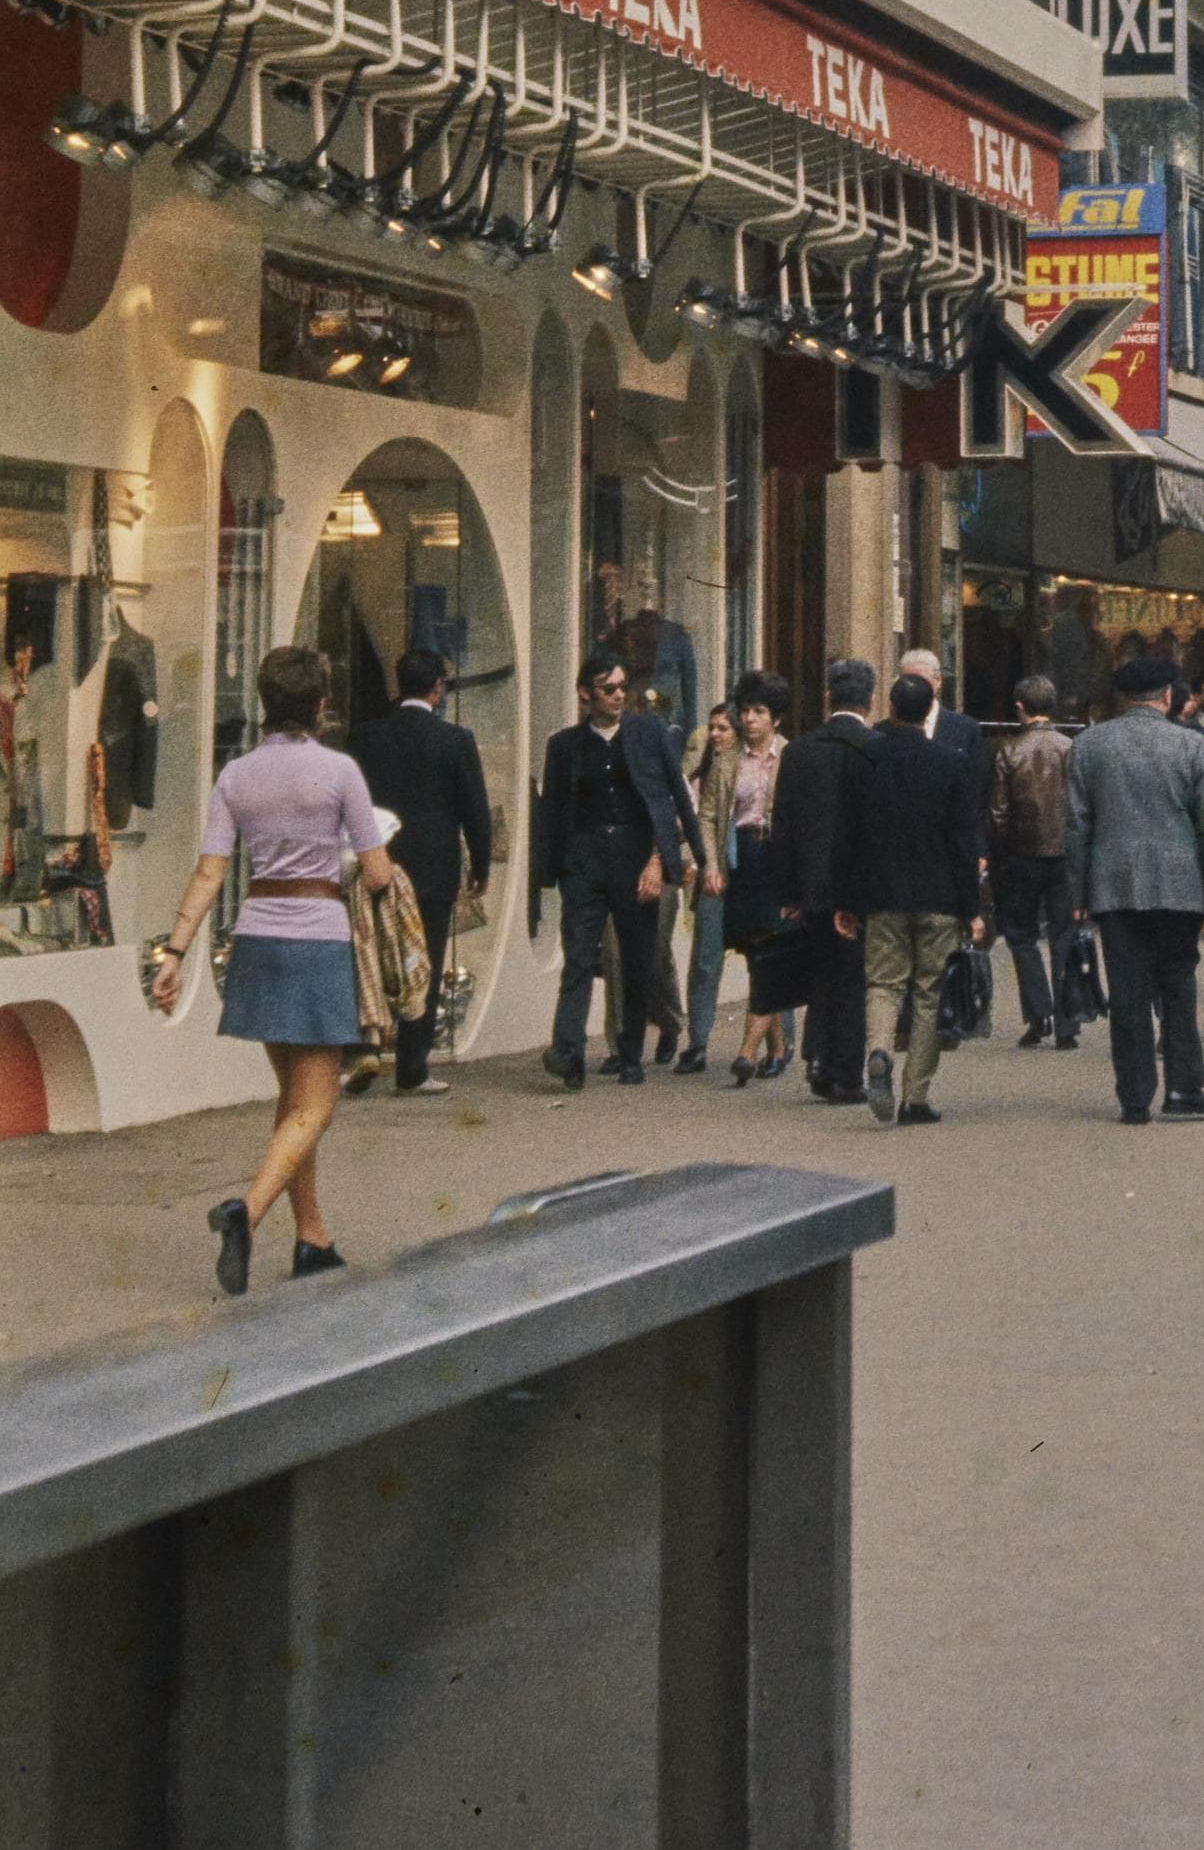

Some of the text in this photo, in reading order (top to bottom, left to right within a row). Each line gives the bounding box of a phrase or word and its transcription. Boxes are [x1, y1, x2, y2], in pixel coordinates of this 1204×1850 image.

[806, 33, 891, 140] TEKA
[967, 117, 1034, 207] TEKA
[962, 298, 1158, 459] K
